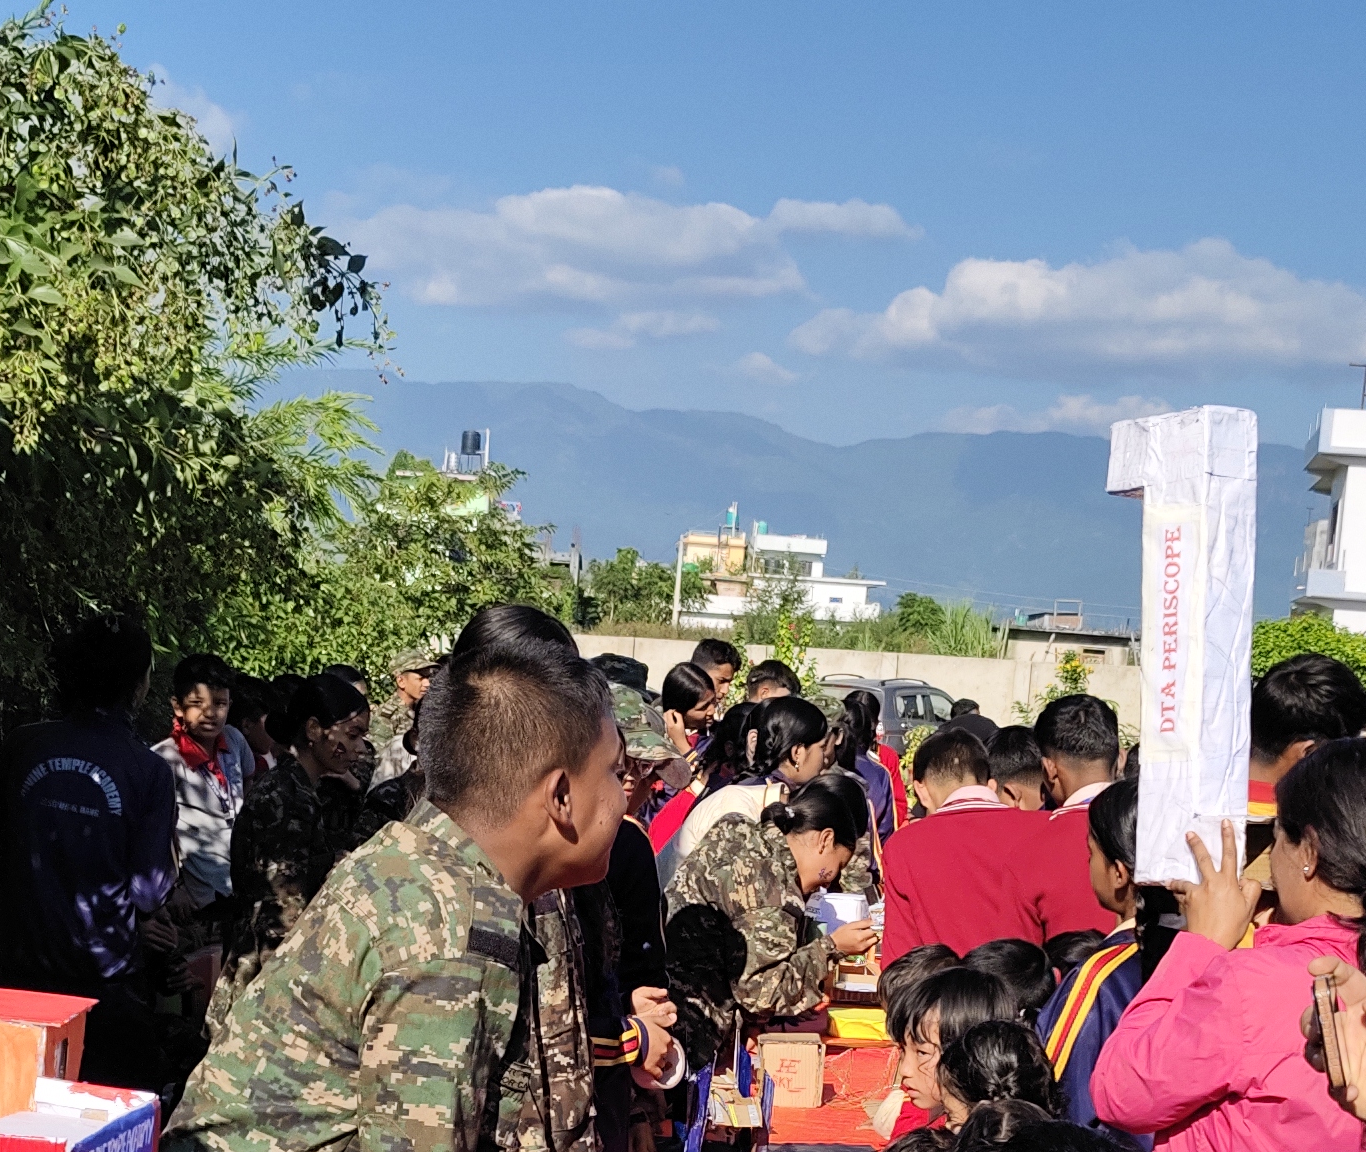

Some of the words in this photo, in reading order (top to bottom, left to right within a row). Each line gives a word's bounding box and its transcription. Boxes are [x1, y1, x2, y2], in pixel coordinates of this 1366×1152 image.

[1161, 525, 1182, 671] PERISCOPE
[1159, 680, 1177, 734] DTA
[47, 757, 93, 774] TEMPLE
[88, 764, 123, 817] ACADEMY
